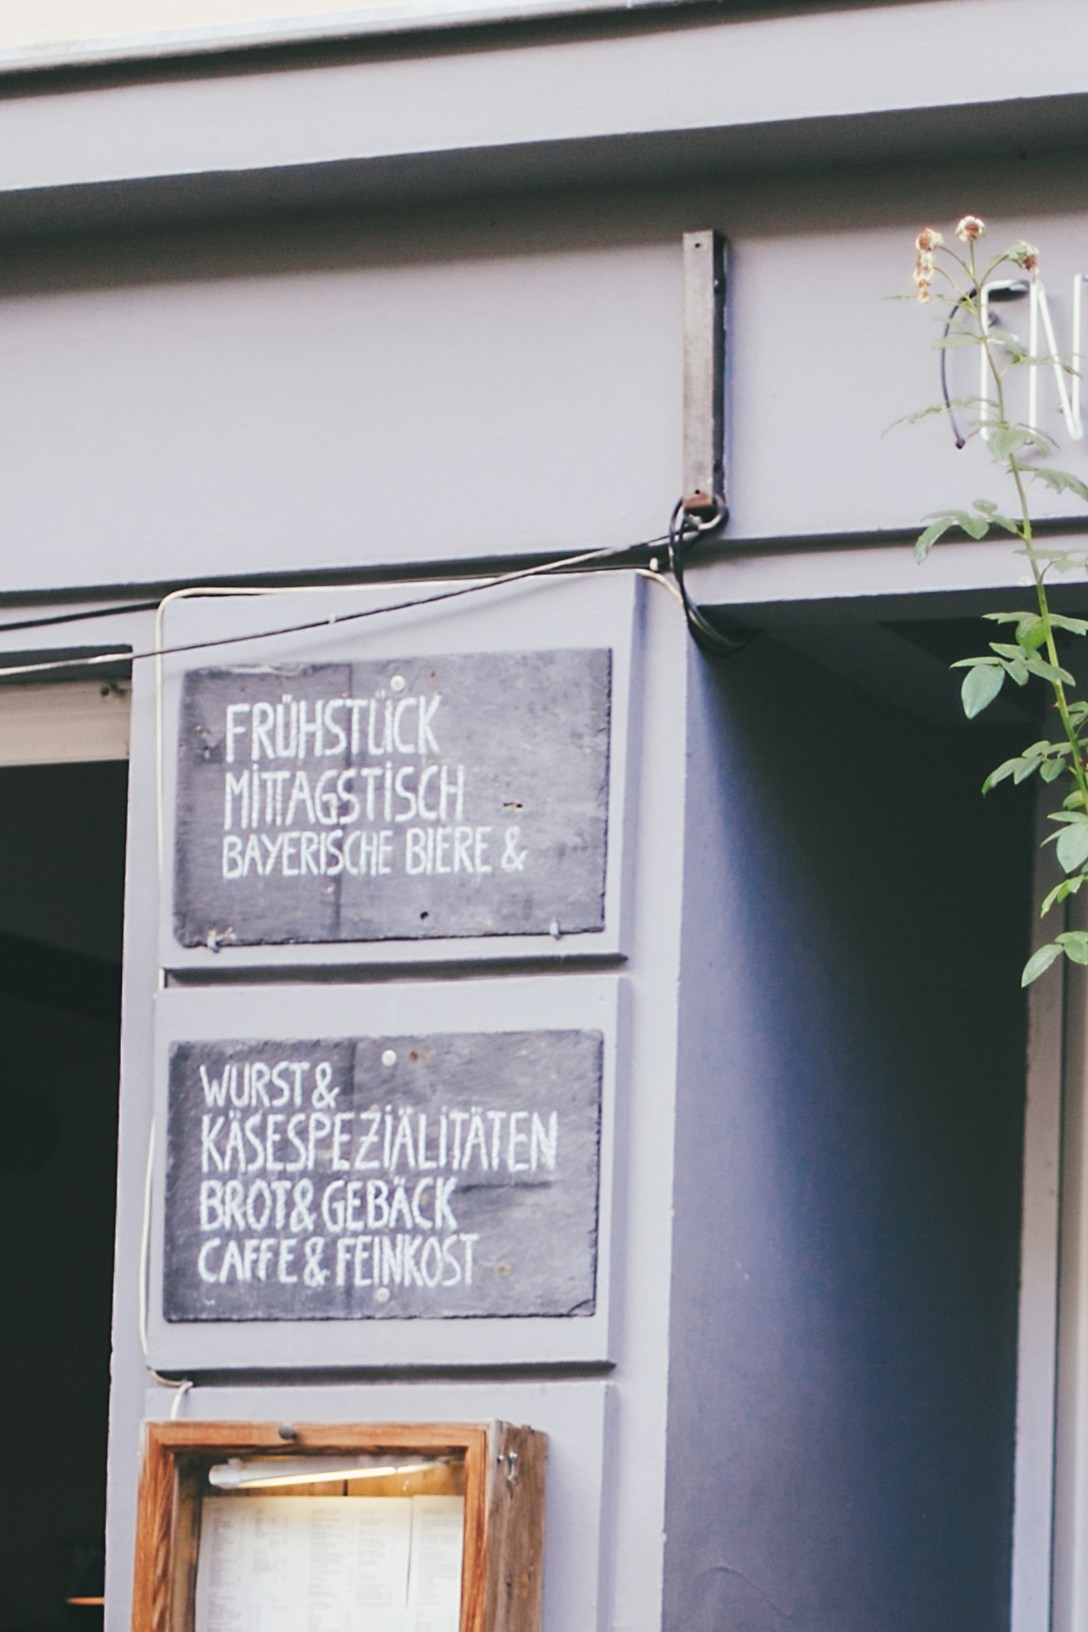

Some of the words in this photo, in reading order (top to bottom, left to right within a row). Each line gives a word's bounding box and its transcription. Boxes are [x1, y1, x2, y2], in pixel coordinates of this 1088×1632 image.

[225, 689, 442, 764] FRÜHSTÜCK
[222, 830, 391, 879] BAYERISCHE
[406, 825, 492, 875] BIERE
[501, 825, 529, 871] &
[200, 1062, 310, 1108] WURST
[312, 1062, 341, 1108] &
[200, 1180, 291, 1232] BROT
[289, 1183, 317, 1232] &
[321, 1176, 459, 1232] GEBÄCK
[198, 1237, 298, 1284] CAFFE
[303, 1237, 330, 1287] &
[336, 1233, 480, 1287] FEINKOST
